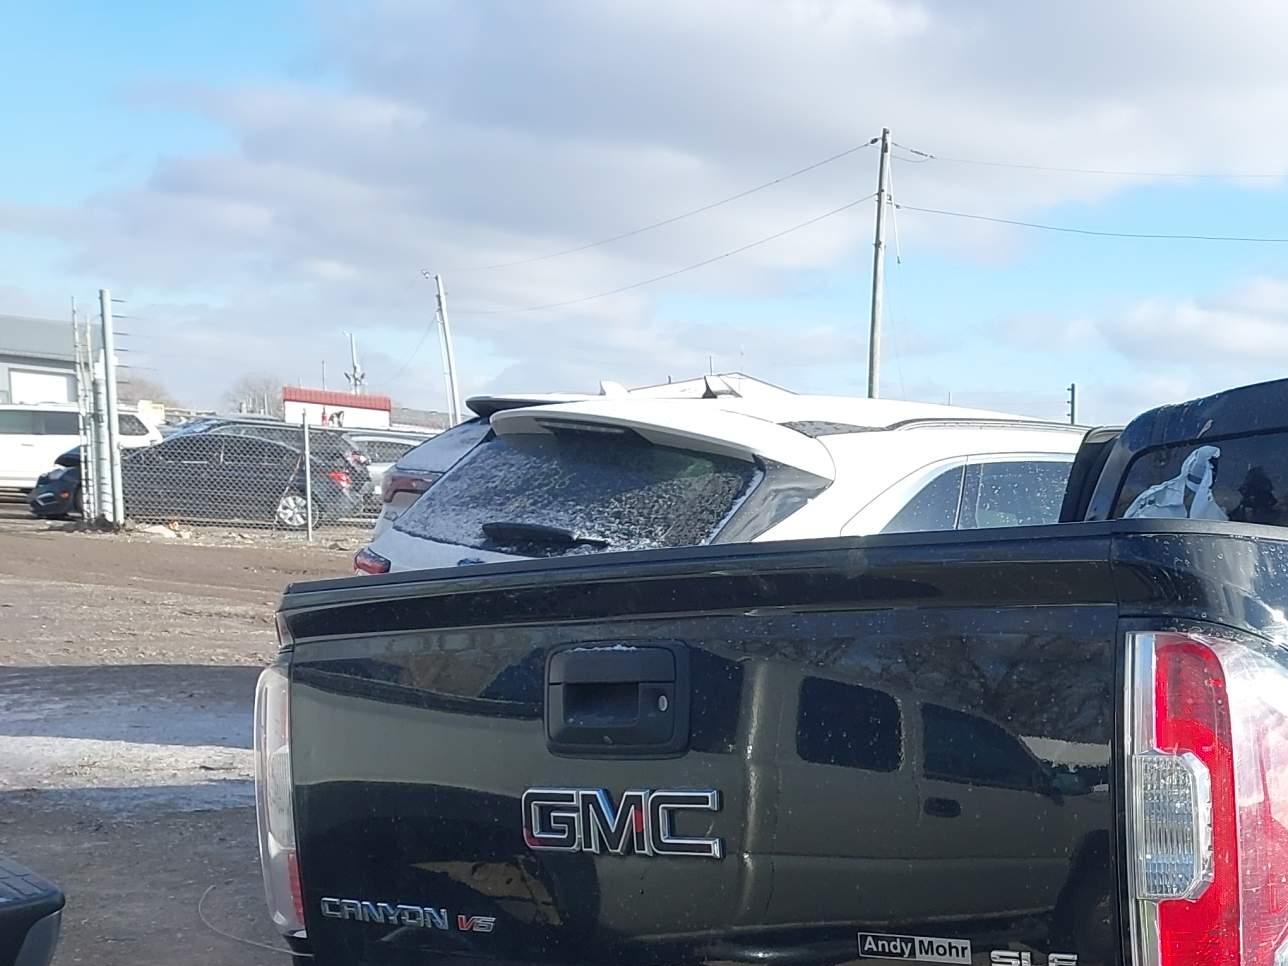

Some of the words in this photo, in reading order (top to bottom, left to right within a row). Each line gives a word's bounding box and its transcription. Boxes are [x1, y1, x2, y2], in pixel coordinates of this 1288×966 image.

[521, 788, 721, 859] GMC
[320, 897, 449, 930] CANYON
[457, 914, 497, 933] V6
[863, 935, 913, 958] Andy
[918, 939, 969, 959] Mohr
